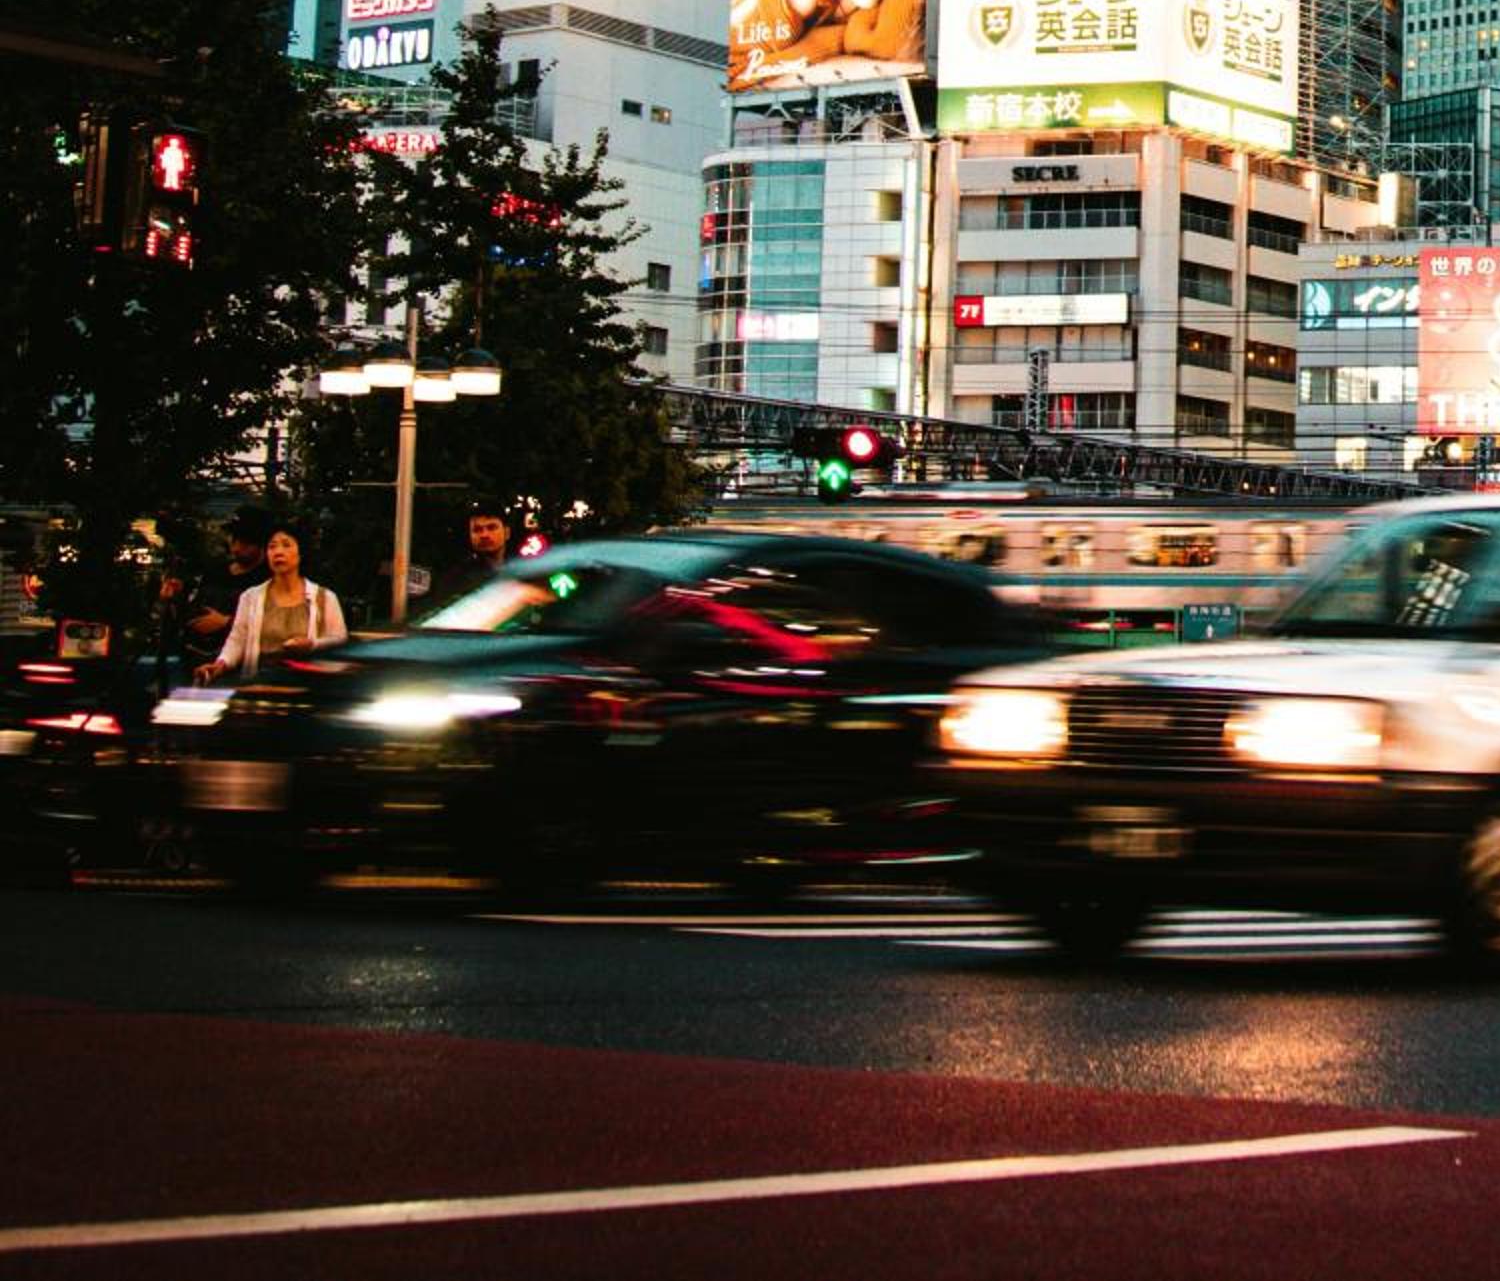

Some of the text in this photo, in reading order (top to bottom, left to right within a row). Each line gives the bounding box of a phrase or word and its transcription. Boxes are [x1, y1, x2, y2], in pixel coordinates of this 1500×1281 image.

[736, 20, 792, 45] Life is
[1035, 8, 1138, 42] 英会話
[347, 27, 430, 70] ODAKYU
[964, 90, 1083, 124] 新宿本校
[1012, 164, 1081, 183] SECRE
